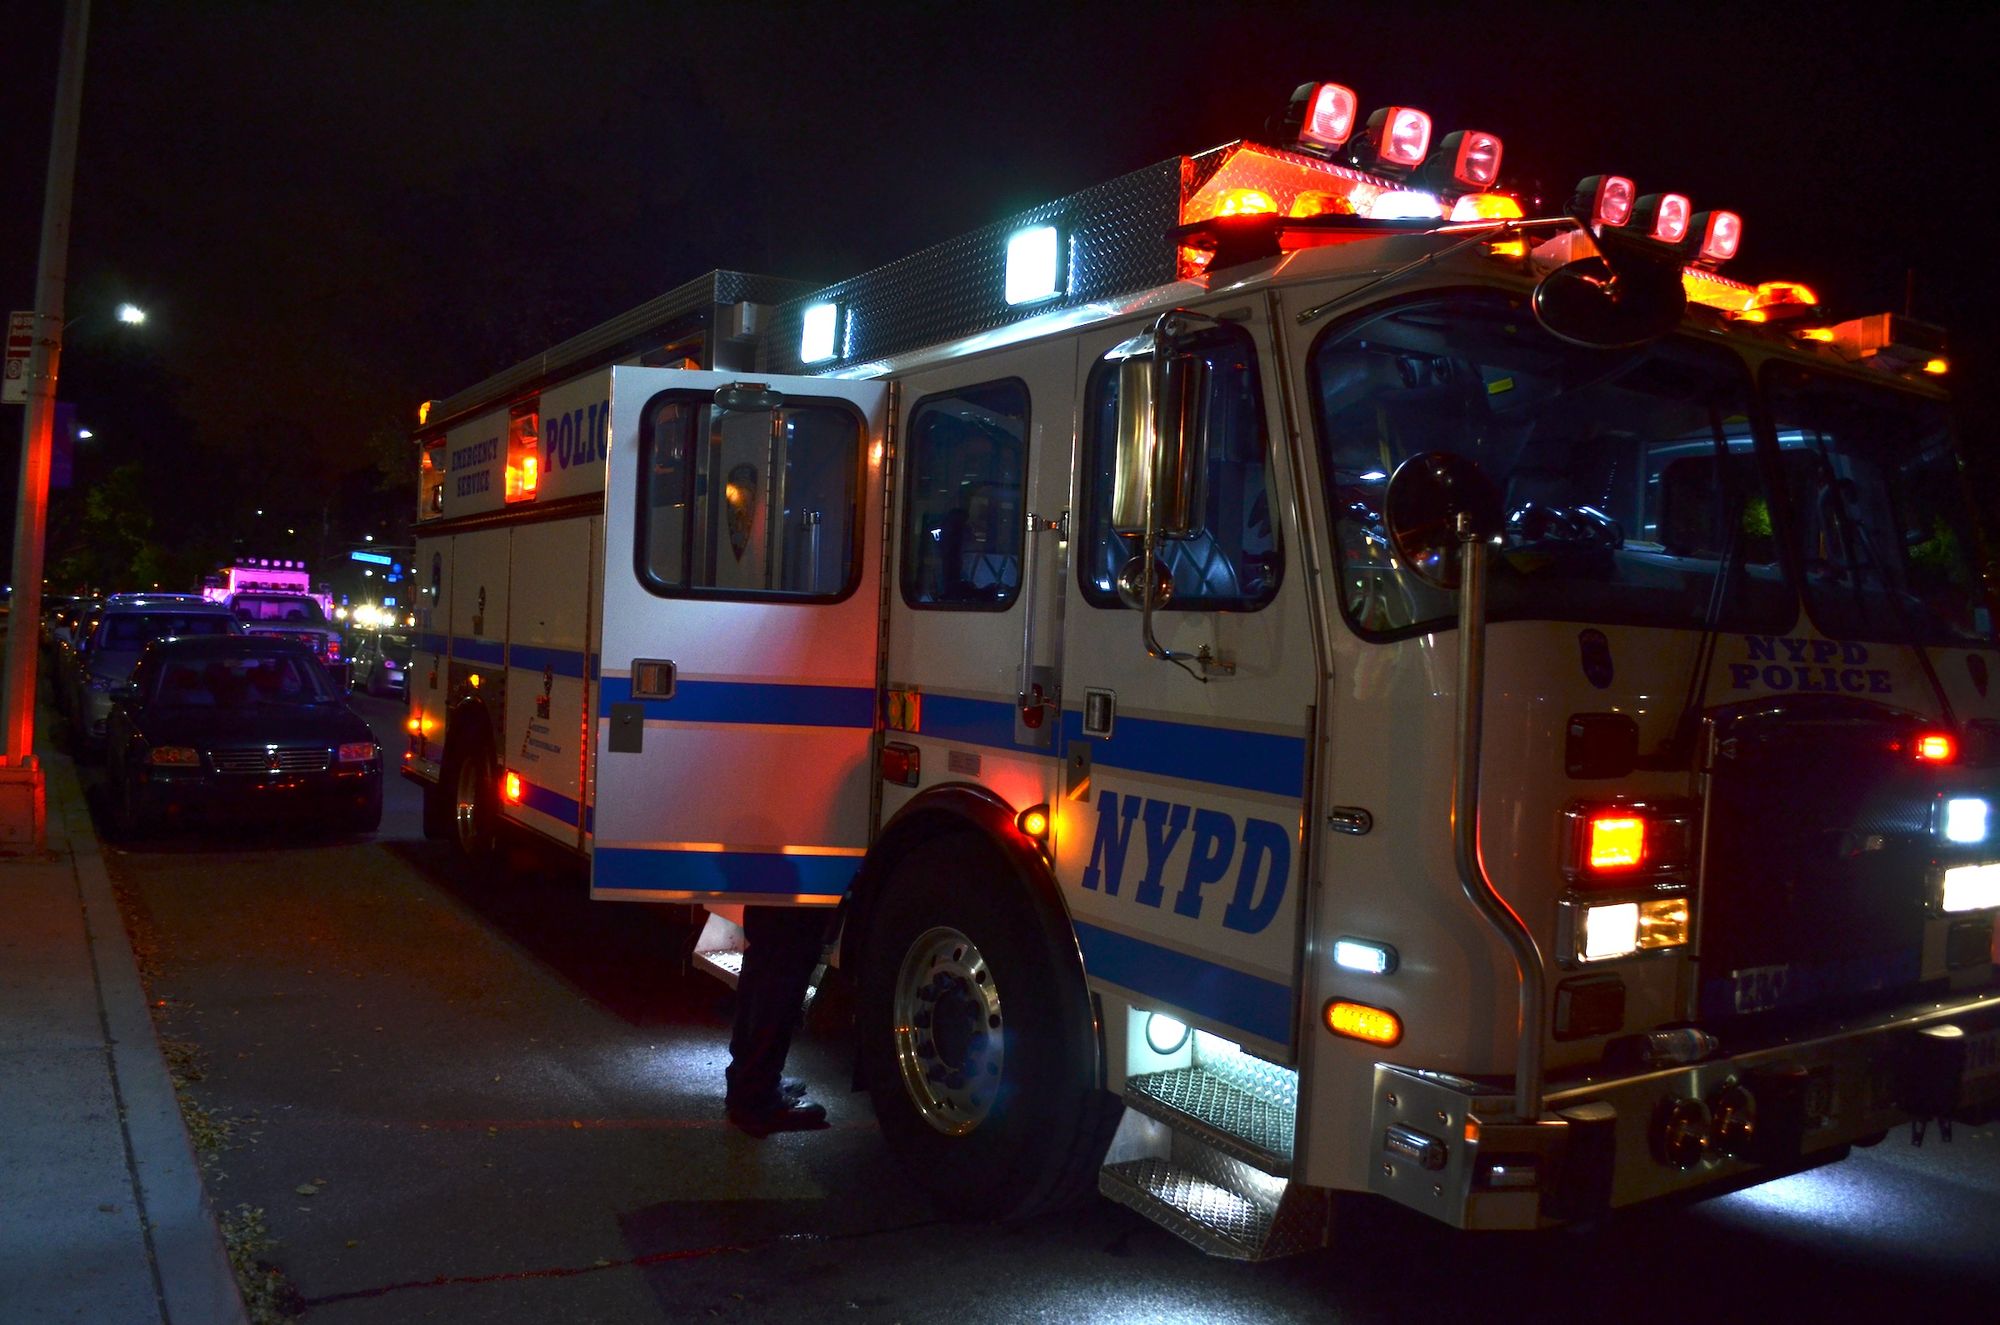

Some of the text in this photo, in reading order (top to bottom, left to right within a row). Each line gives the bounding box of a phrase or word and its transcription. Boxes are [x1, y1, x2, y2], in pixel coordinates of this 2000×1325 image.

[452, 437, 498, 472] EMERGENCY
[457, 469, 490, 497] SERVICE
[1744, 636, 1869, 665] NYPD
[1729, 663, 1892, 693] POLICE
[1082, 790, 1290, 934] NYPD
